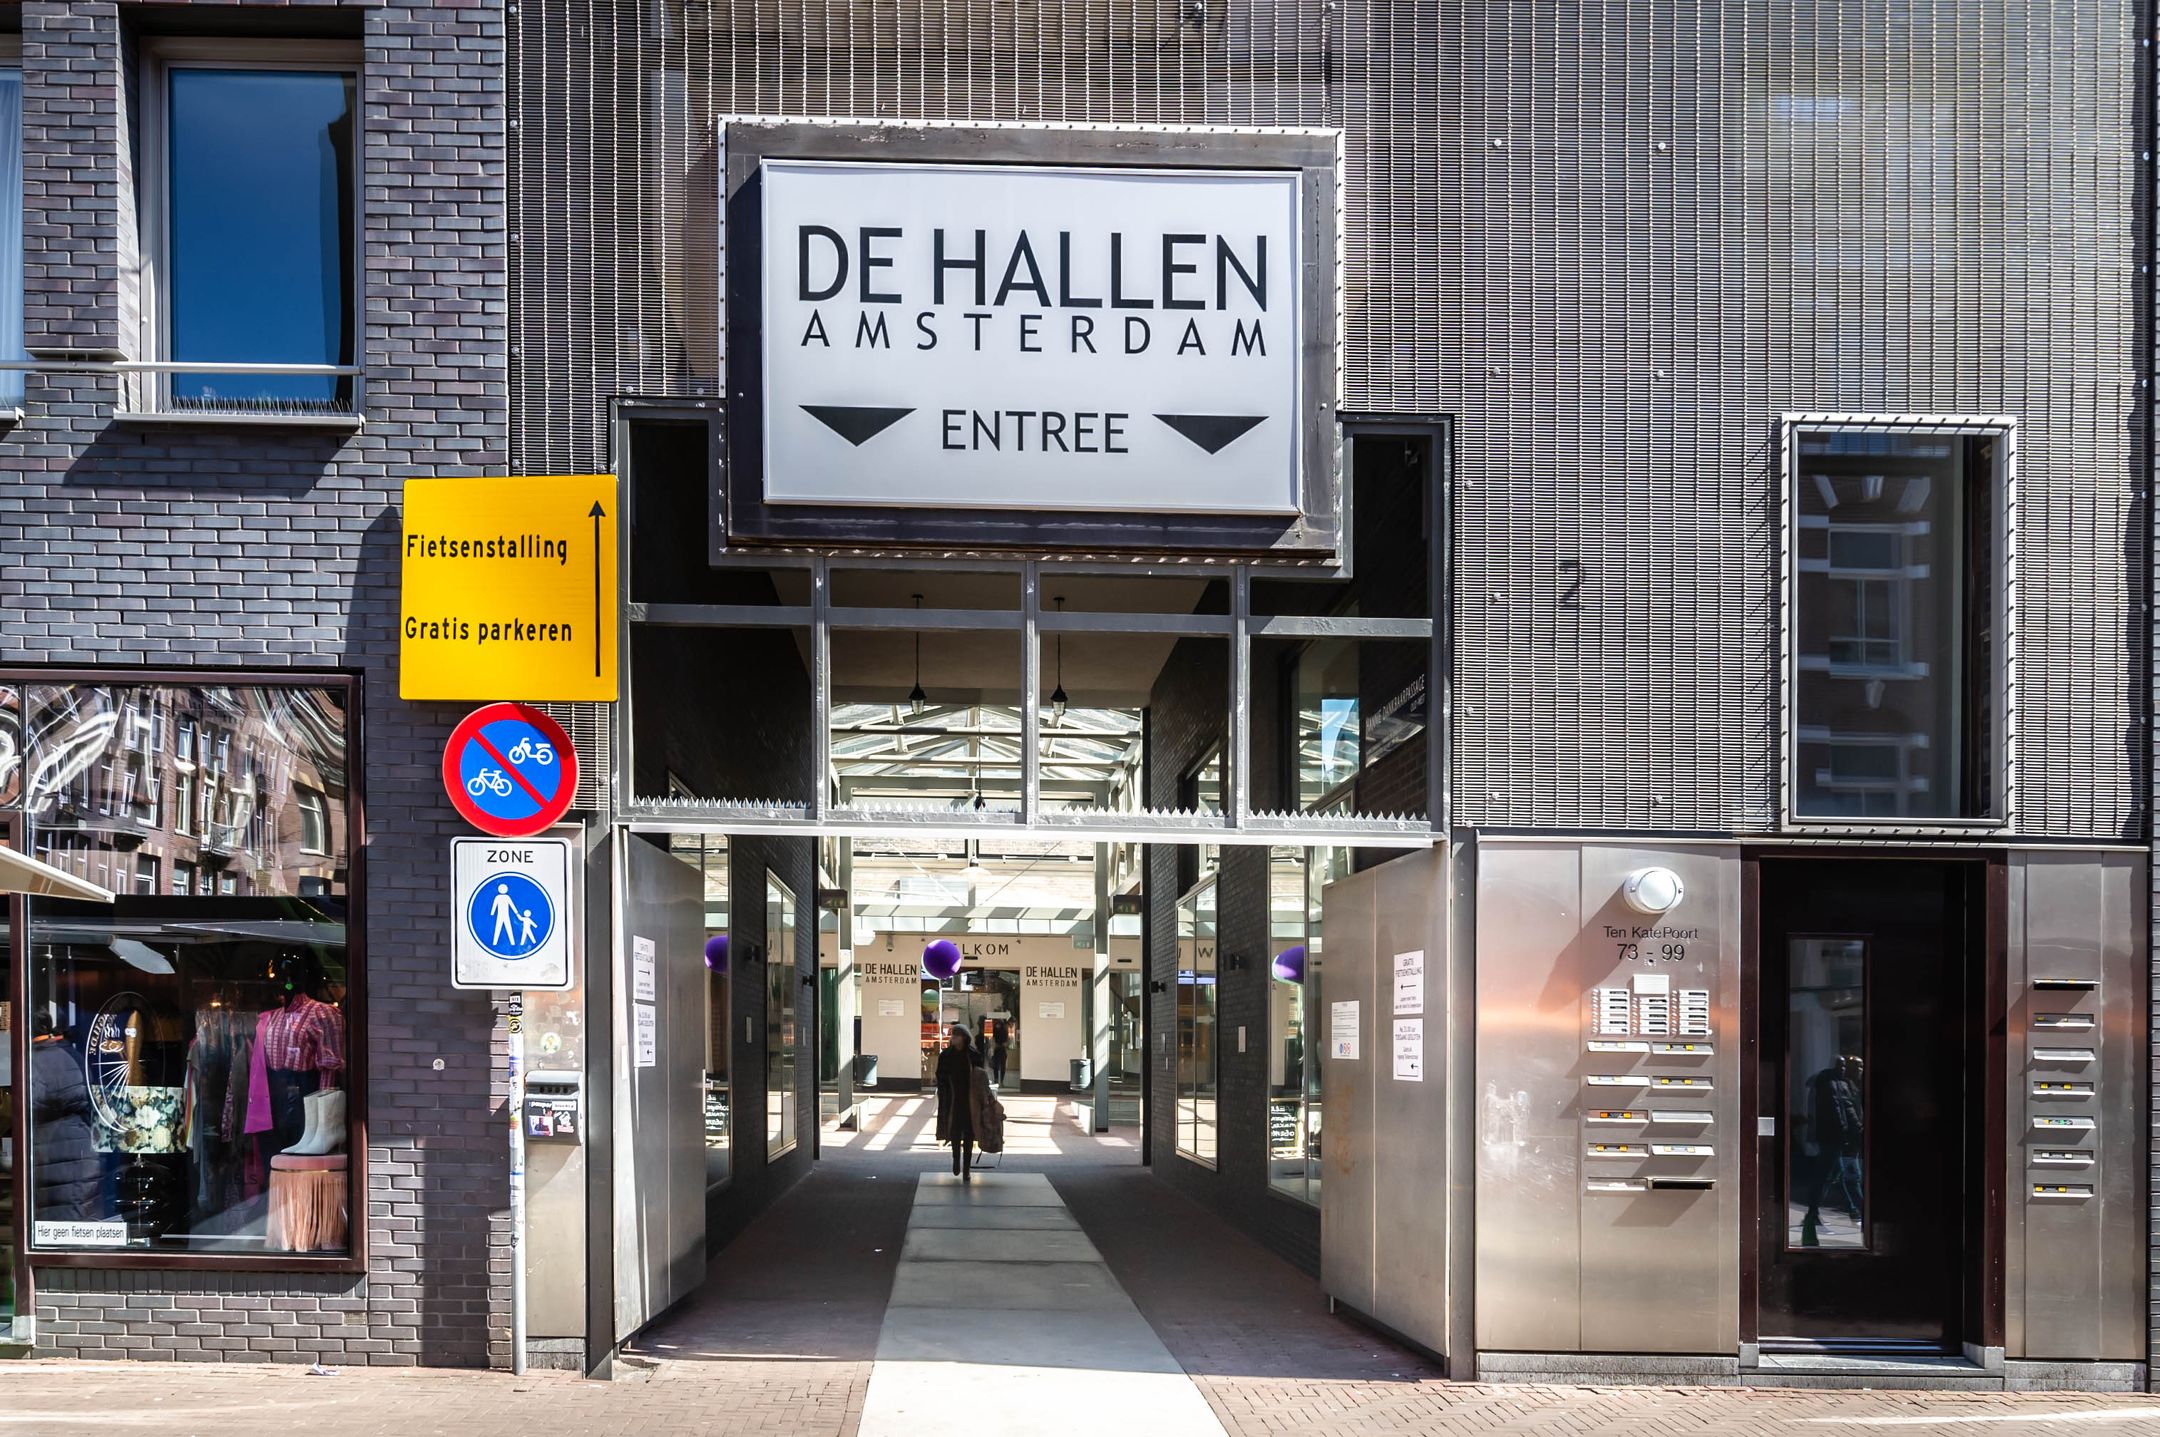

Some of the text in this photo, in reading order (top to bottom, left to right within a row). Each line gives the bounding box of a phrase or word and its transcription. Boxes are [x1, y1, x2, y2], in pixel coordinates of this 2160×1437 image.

[798, 224, 1268, 313] DE HALLEN
[800, 308, 1267, 357] AMSTERDAM
[941, 408, 1130, 454] ENTREE
[406, 534, 568, 566] Fietsenstalling
[405, 616, 573, 645] Gratis parkeren
[487, 850, 534, 863] ZONE
[1603, 926, 1627, 939] Ten
[953, 943, 1009, 955] LKOM
[1616, 943, 1639, 960] 73
[1661, 944, 1686, 961] 99
[865, 963, 918, 976] DE HALLEN
[1025, 966, 1078, 979] DE HALLEN
[865, 976, 918, 985] AMSTERDAM
[1025, 979, 1078, 988] AMSTERDAM
[37, 1225, 125, 1241] Hier geen fietsen plaatsen
